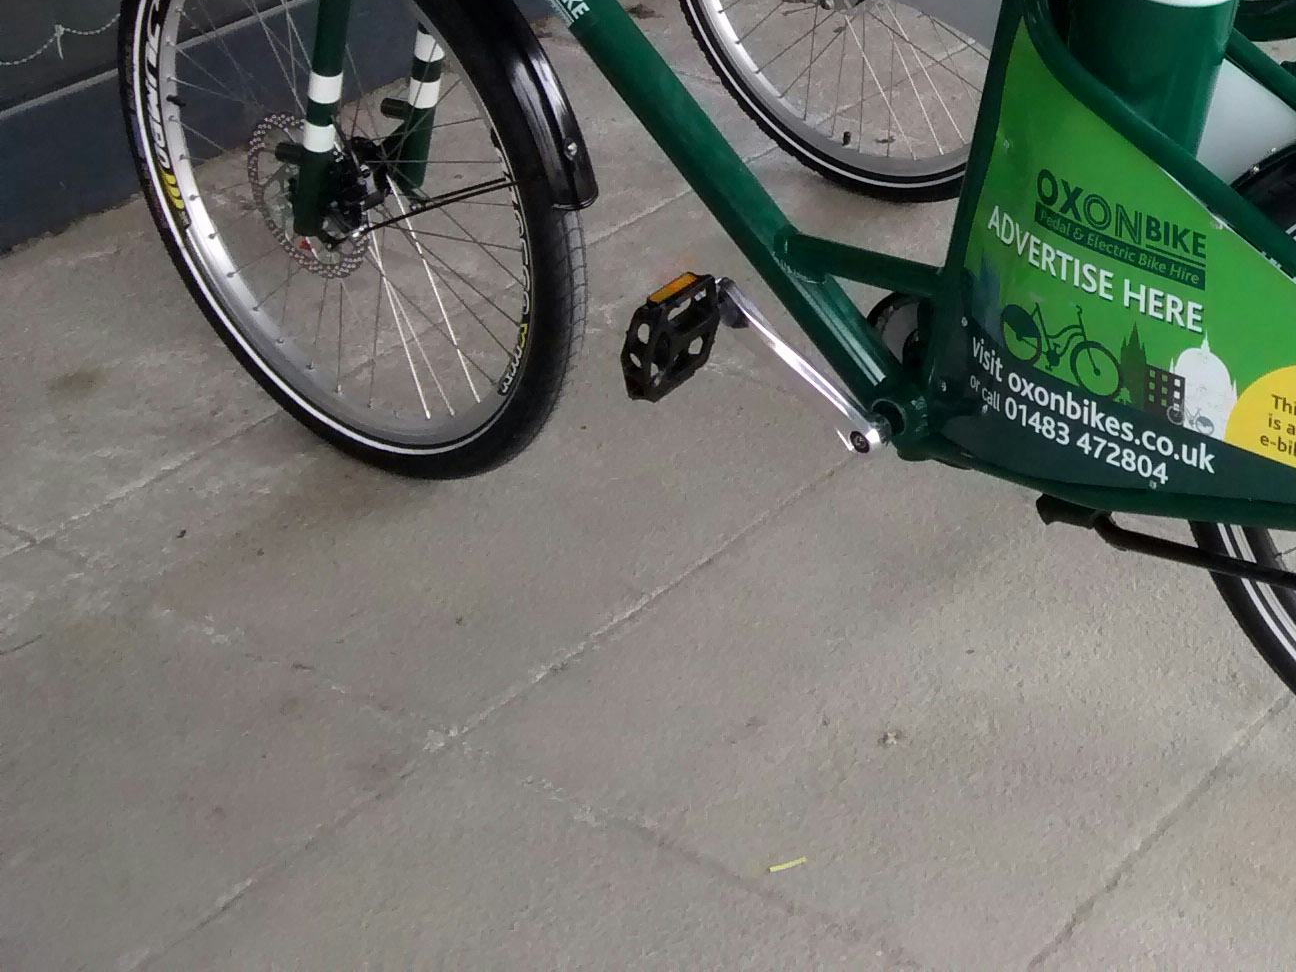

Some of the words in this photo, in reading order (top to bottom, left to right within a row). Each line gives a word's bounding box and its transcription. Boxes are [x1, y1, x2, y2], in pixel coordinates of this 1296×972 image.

[1036, 168, 1207, 259] OXONBIKE
[1040, 210, 1070, 242] Pedal
[1072, 230, 1085, 241] &
[1086, 234, 1135, 262] Electric
[1137, 253, 1167, 274] Bike
[1169, 263, 1200, 285] Hire
[987, 204, 1115, 301] ADVERTISE
[1123, 278, 1204, 333] HERE
[970, 375, 981, 394] or
[981, 383, 1001, 412] call
[1004, 397, 1070, 446] 01483
[1076, 431, 1168, 485] 472804
[972, 336, 1004, 382] visit
[1007, 372, 1216, 474] oxonbikes.co.uk
[1268, 413, 1281, 430] is
